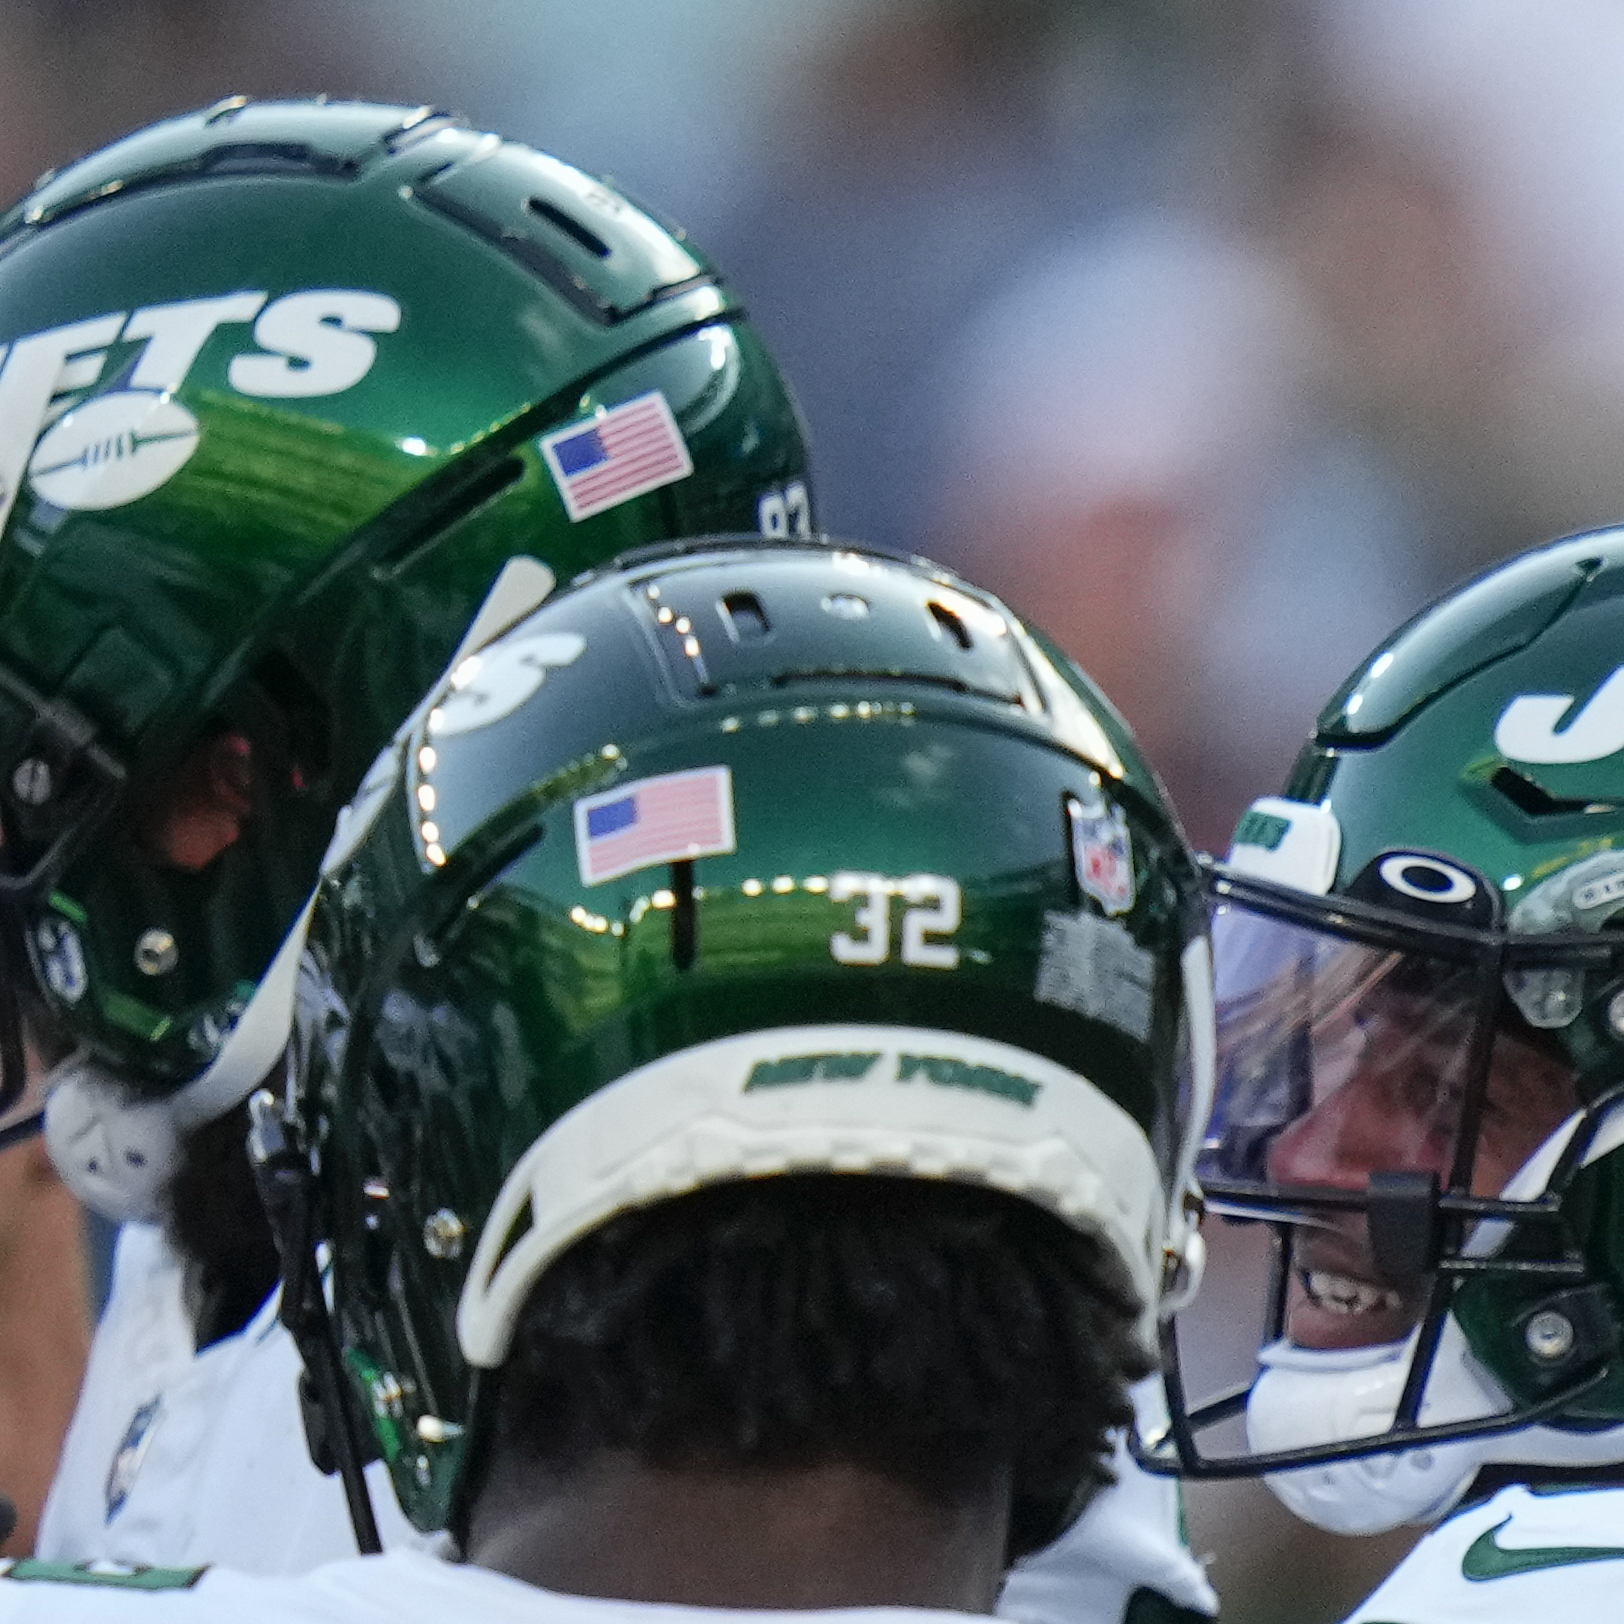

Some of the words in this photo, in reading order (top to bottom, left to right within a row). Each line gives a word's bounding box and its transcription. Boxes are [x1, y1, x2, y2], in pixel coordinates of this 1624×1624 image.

[0, 288, 401, 422] ETS
[829, 870, 961, 969] 32
[743, 1052, 882, 1093] NEW
[896, 1053, 1043, 1106] YORK
